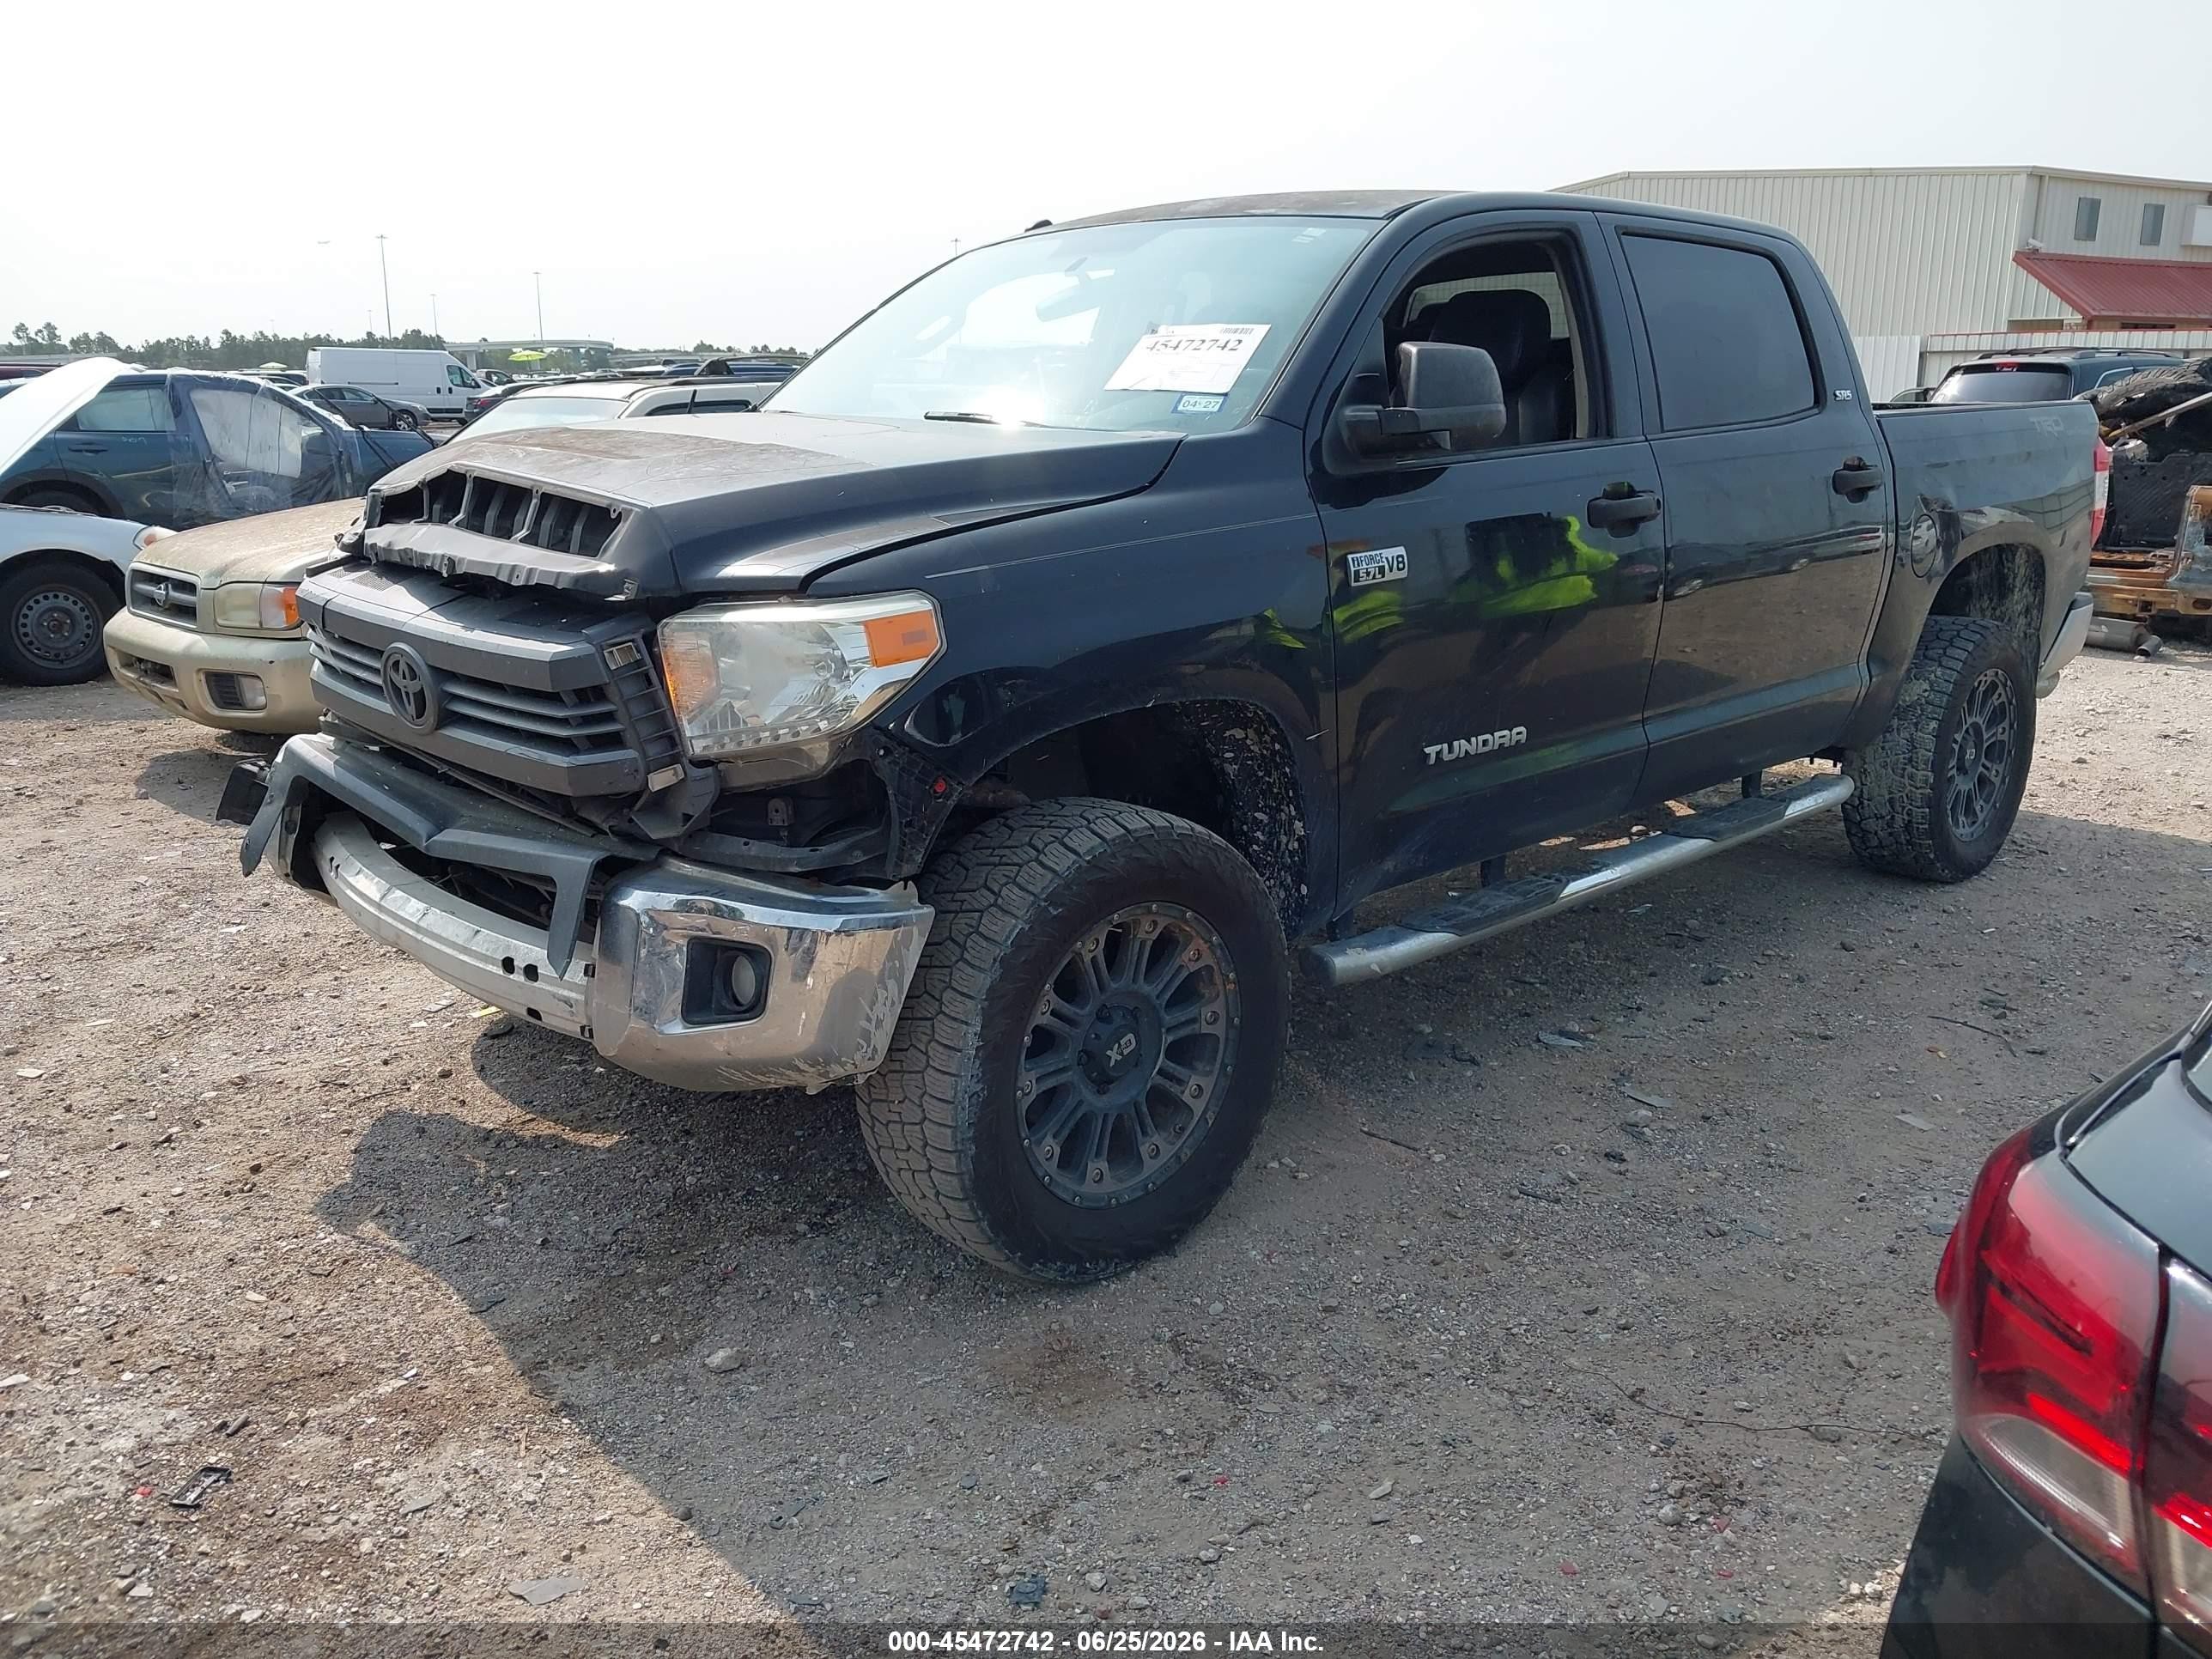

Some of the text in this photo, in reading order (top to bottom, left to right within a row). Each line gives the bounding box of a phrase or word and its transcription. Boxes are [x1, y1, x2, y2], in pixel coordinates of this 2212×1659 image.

[1146, 338, 1243, 351] 45472742
[1834, 389, 1852, 401] SR5
[1182, 399, 1219, 410] 04 27
[1385, 554, 1407, 573] V8
[1423, 726, 1528, 765] TUNDRA
